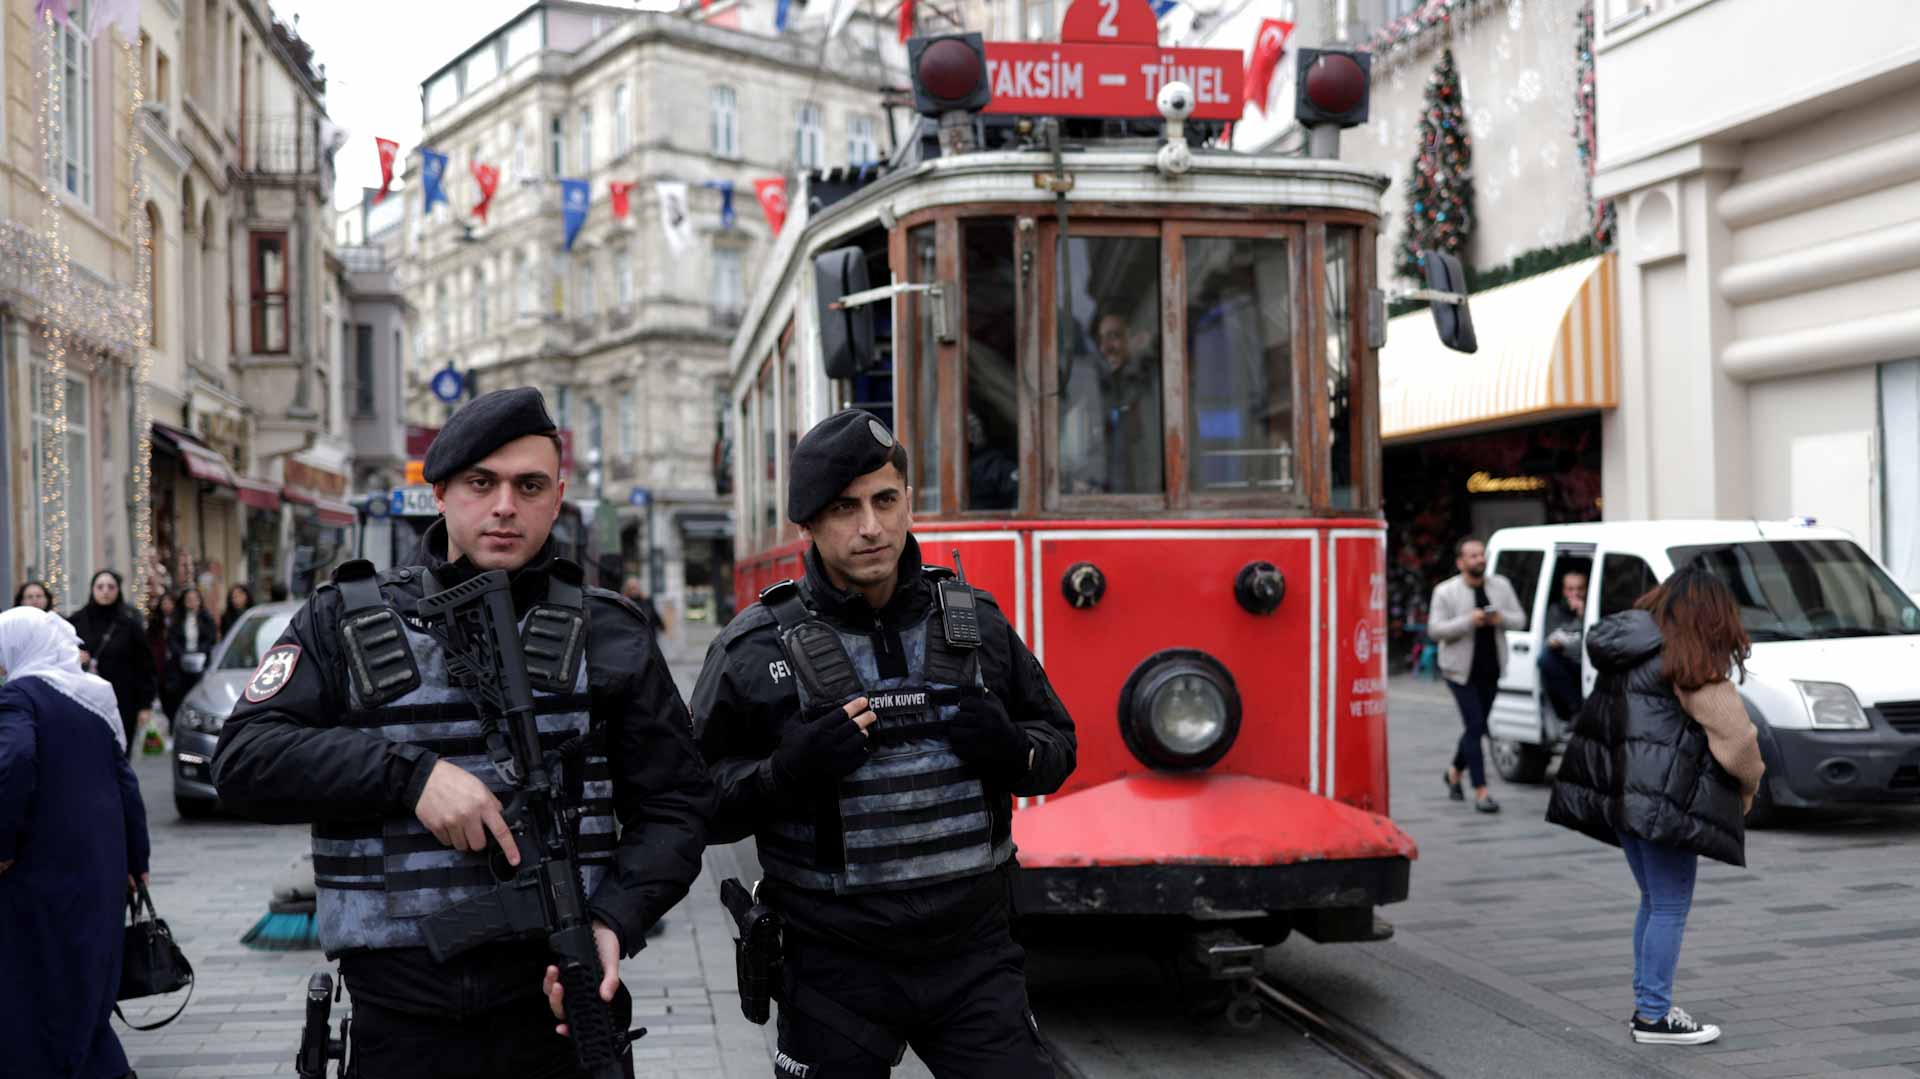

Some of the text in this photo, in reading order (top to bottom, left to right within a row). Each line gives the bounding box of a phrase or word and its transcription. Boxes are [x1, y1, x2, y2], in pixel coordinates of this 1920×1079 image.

[1097, 0, 1120, 38] 2
[986, 51, 1084, 99] TAKSİM
[1141, 54, 1231, 104] TÜNEL
[869, 692, 926, 712] ÇEVİK KUVVET
